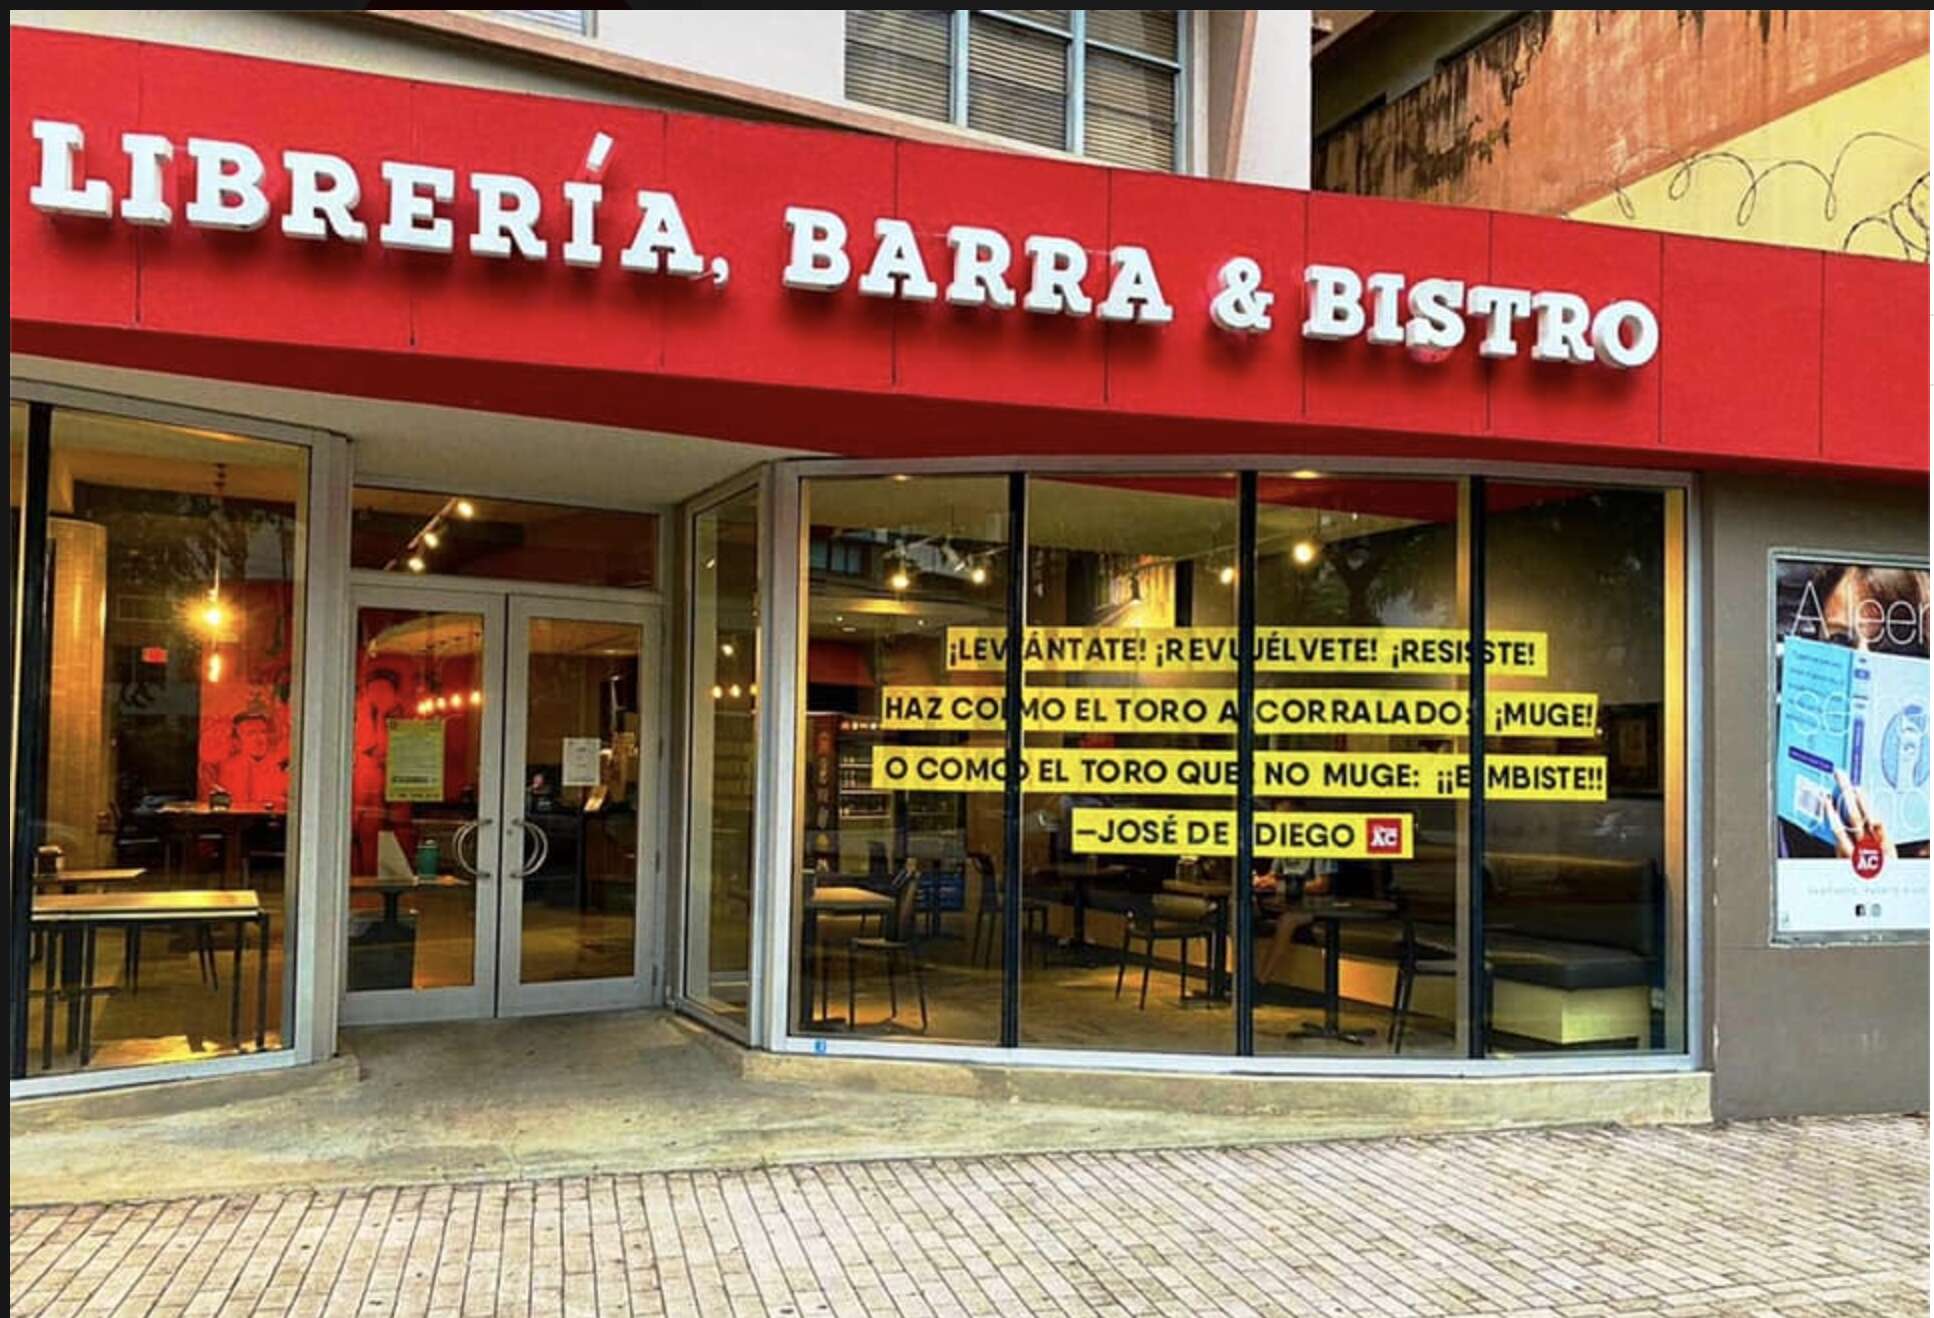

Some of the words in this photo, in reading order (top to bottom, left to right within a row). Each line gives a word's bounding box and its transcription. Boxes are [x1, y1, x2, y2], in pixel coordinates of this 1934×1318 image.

[29, 119, 730, 285] LIBRERÍA,
[782, 206, 1174, 323] BARRA
[1210, 256, 1273, 333] &
[1303, 264, 1660, 369] BISTRO
[1790, 580, 1831, 640] A
[949, 631, 1147, 667] ¡LEVÁNTATE!
[1156, 631, 1378, 668] ¡REVUÉLVETE!
[1392, 638, 1536, 668] ¡RESISTE!
[885, 696, 943, 721] HAZ
[951, 696, 1066, 722] COMO
[1075, 698, 1108, 722] EL
[1116, 698, 1208, 724] TORO
[1495, 701, 1594, 732] ¡MUGE!
[885, 756, 908, 781] O
[916, 756, 1030, 782] COMO
[1039, 758, 1069, 783] EL
[1081, 758, 1168, 785] TORO
[1177, 759, 1254, 786] QUE
[1265, 761, 1310, 787] NO
[1323, 762, 1420, 789] MUGE:
[1437, 764, 1604, 795] ¡¡EMBISTE!!
[1187, 820, 1230, 844] DE
[1256, 822, 1355, 848] DIEGO
[1857, 853, 1880, 870] AC
